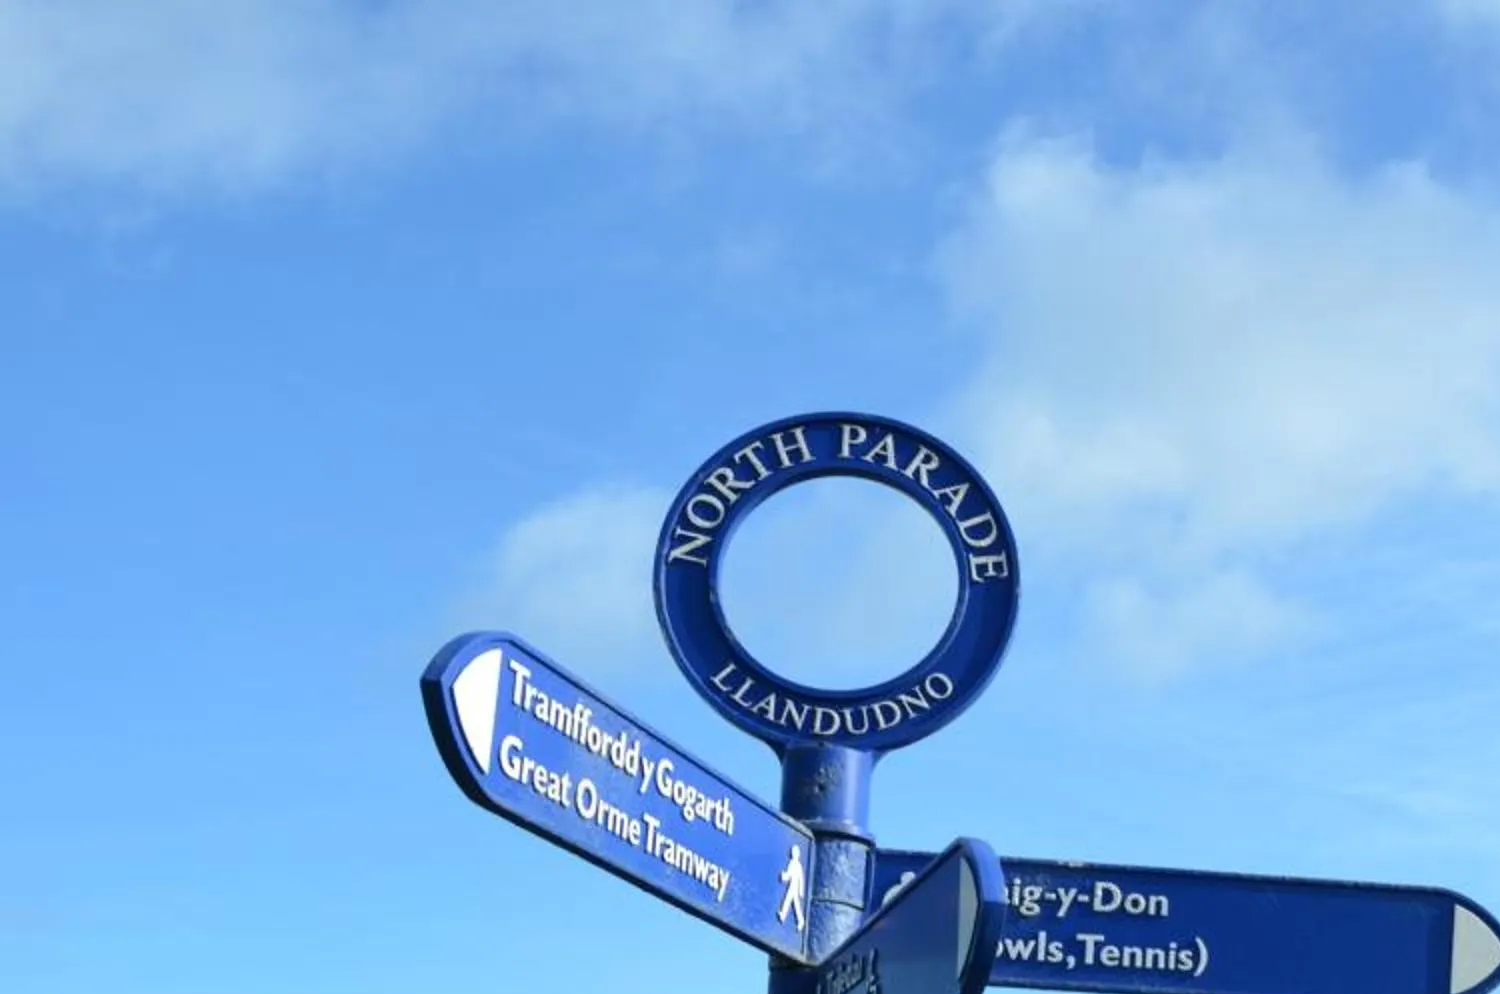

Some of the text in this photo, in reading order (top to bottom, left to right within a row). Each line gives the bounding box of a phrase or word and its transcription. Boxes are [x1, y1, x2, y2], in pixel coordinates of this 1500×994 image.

[667, 423, 1009, 583] NORTH PARADE
[709, 663, 954, 737] LLANDUDNO
[499, 734, 732, 902] Great Orme Tramway
[656, 758, 735, 837] Gogarth
